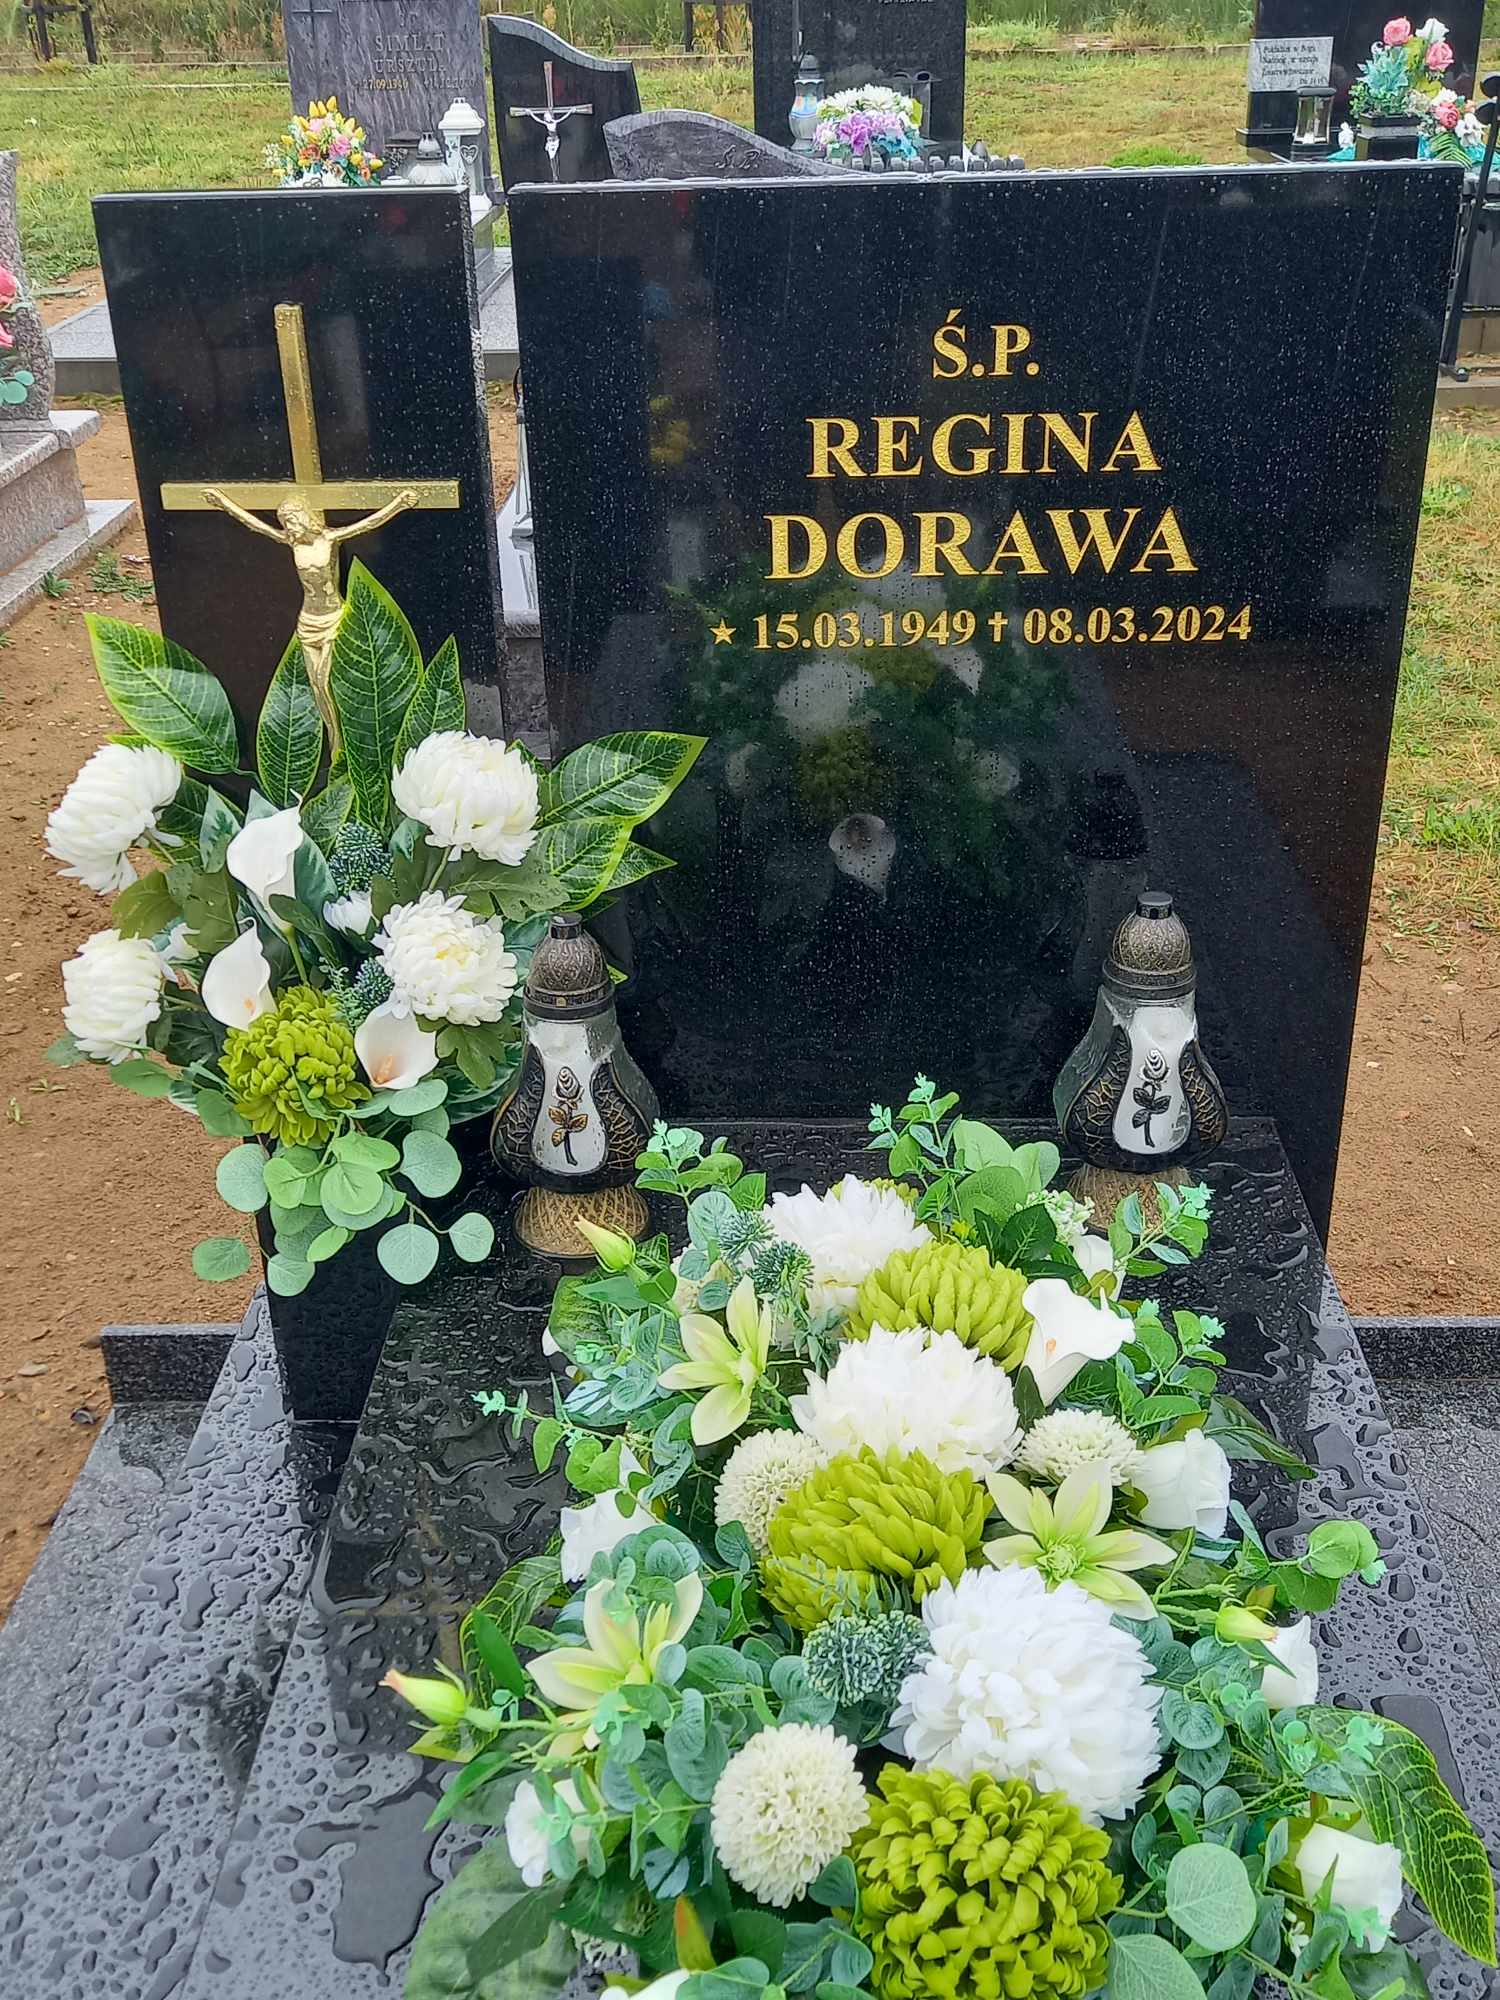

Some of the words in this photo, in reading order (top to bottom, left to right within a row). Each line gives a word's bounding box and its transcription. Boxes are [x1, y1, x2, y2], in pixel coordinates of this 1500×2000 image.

[932, 308, 1040, 378] Ś.P.
[805, 411, 1162, 479] REGINA
[763, 506, 1198, 580] DORAWA
[753, 609, 977, 650] 15.03.1949
[1023, 604, 1253, 645] 08.03.2024
